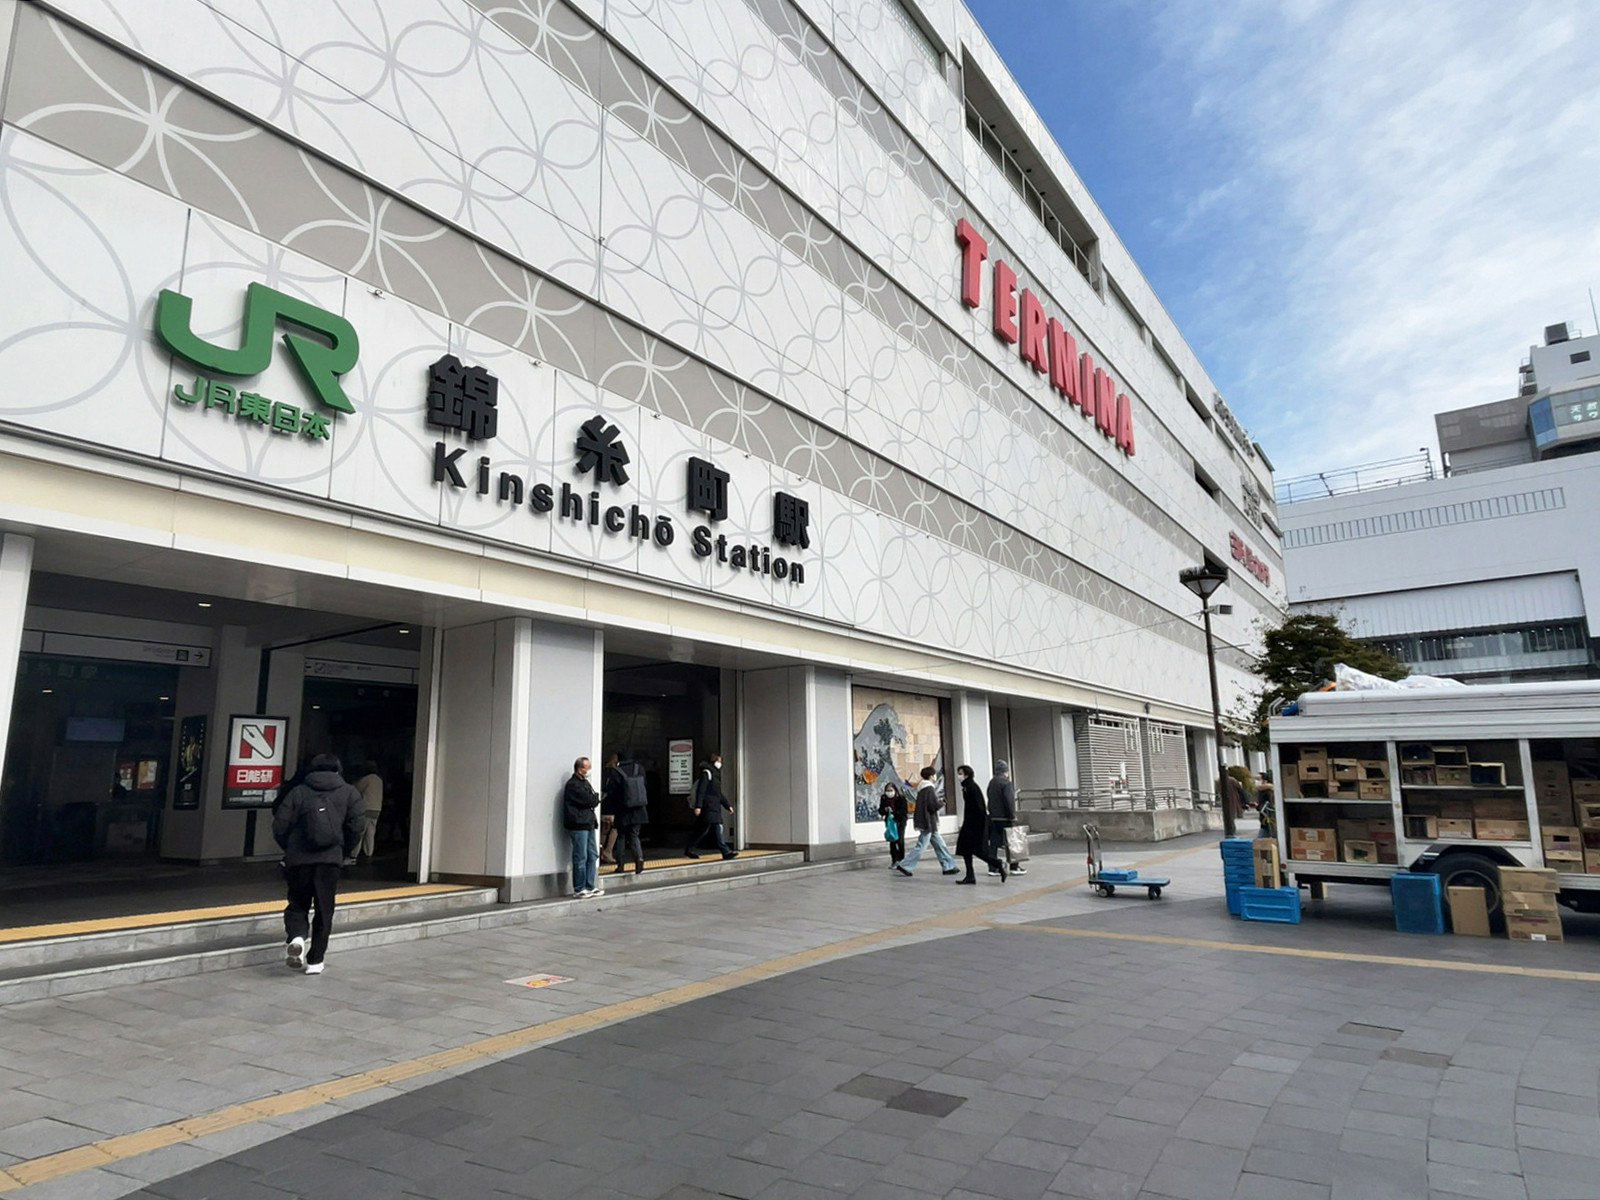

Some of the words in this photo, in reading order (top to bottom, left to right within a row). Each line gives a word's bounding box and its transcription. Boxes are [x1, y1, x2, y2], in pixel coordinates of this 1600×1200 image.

[158, 281, 360, 414] JR
[956, 217, 1135, 456] TERMINA
[174, 376, 332, 441] JR東日本
[426, 353, 811, 549] 錦糸町駅
[433, 441, 674, 547] Kinshichō
[692, 525, 805, 583] Station
[236, 769, 274, 783] 日能研
